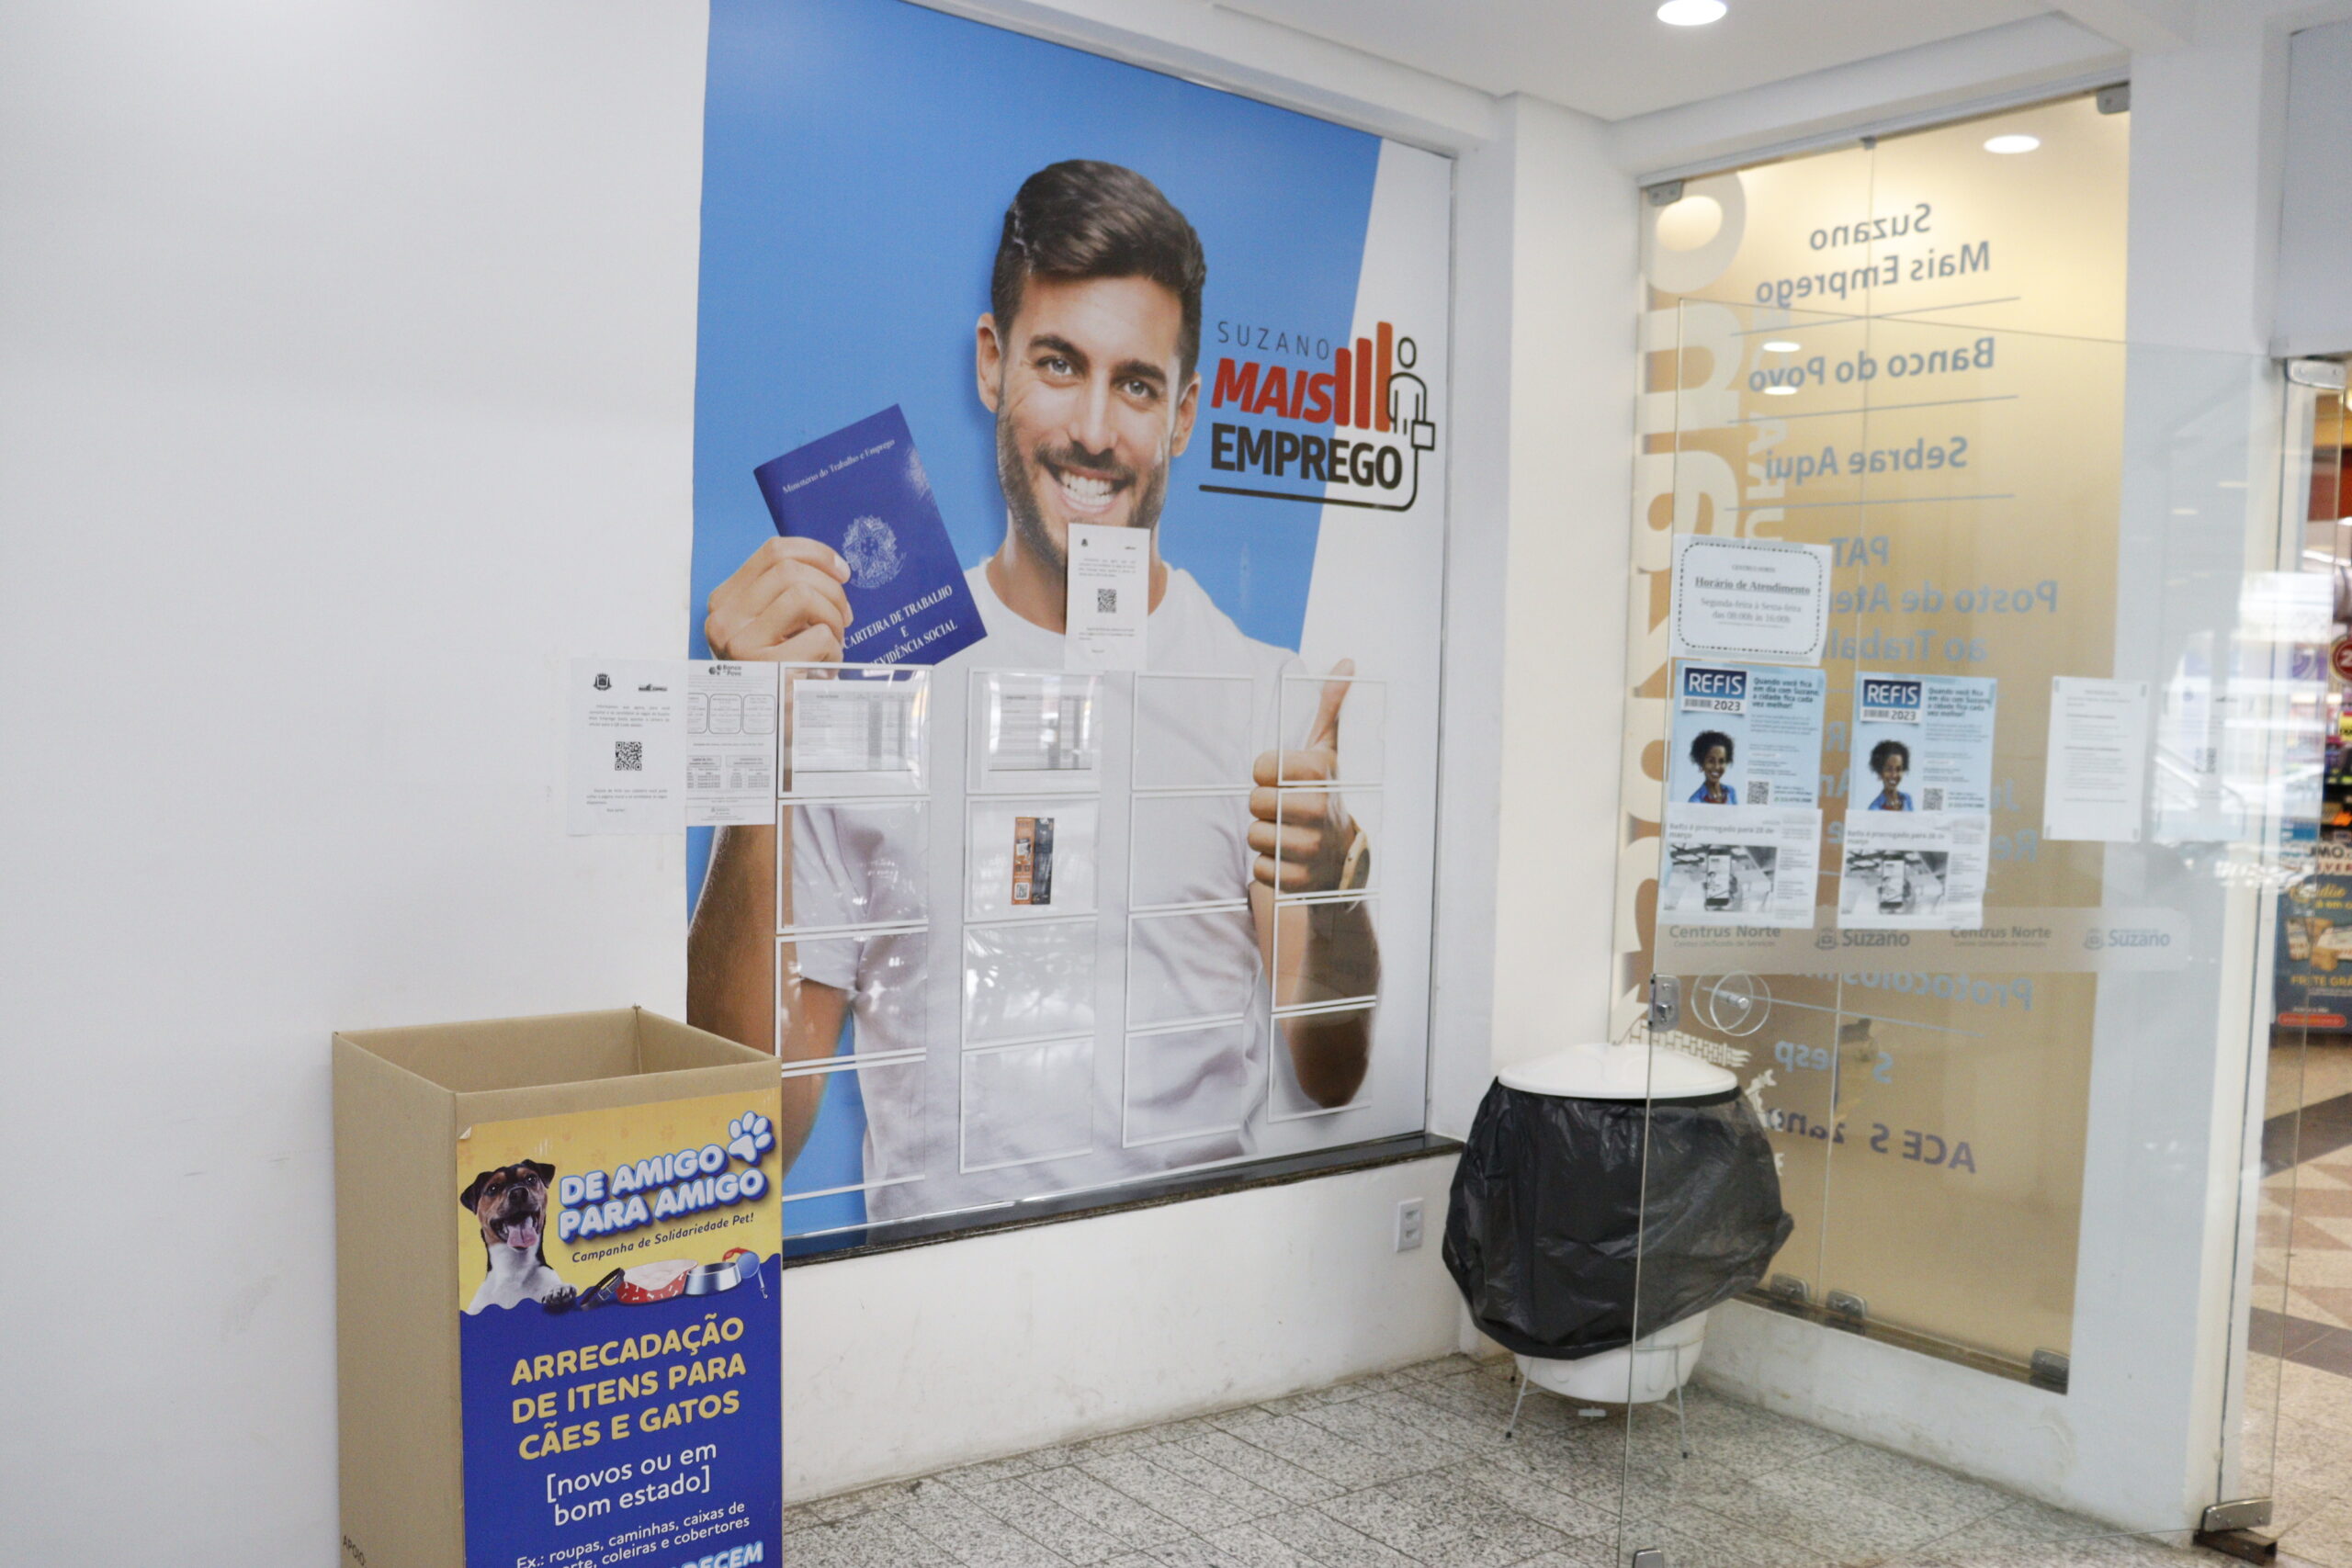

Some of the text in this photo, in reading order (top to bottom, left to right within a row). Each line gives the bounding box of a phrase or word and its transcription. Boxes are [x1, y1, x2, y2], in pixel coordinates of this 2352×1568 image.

[1217, 321, 1329, 361] SUZANO
[1211, 357, 1335, 423] MAIS
[1211, 423, 1402, 490] EMPREGO
[1695, 577, 1811, 595] Horário de Atendimento
[843, 584, 953, 649] CARTEIRA DE TRABALHO
[900, 626, 909, 637] E
[870, 619, 957, 664] EVIDÊNCIA SOCIAL
[1689, 672, 1743, 695] REFIS
[1713, 700, 1741, 711] 2023
[1867, 684, 1918, 705] REFIS
[1891, 710, 1917, 721] 2023
[1669, 925, 1781, 938] Centrus Norte
[1842, 929, 1910, 947] Suzano
[1951, 926, 2052, 938] Centrus Norte
[2109, 930, 2170, 947] Suzano
[560, 1144, 729, 1206] DE AMIGO
[559, 1168, 768, 1243] PARA AMIGO
[571, 1213, 754, 1264] Campanha de Solidariedade Pet!
[511, 1313, 744, 1386] ARRECADAÇÃO
[512, 1352, 746, 1424] DE ITENS PARA
[518, 1390, 741, 1461] CÃES E GATOS
[547, 1443, 717, 1504] [novos ou em
[554, 1465, 710, 1527] bom estado]
[549, 1540, 604, 1560] roupas,
[608, 1519, 680, 1547] caminhas,
[683, 1508, 724, 1528] caixas
[728, 1501, 745, 1514] de
[602, 1517, 750, 1564] coleiras e cobertores
